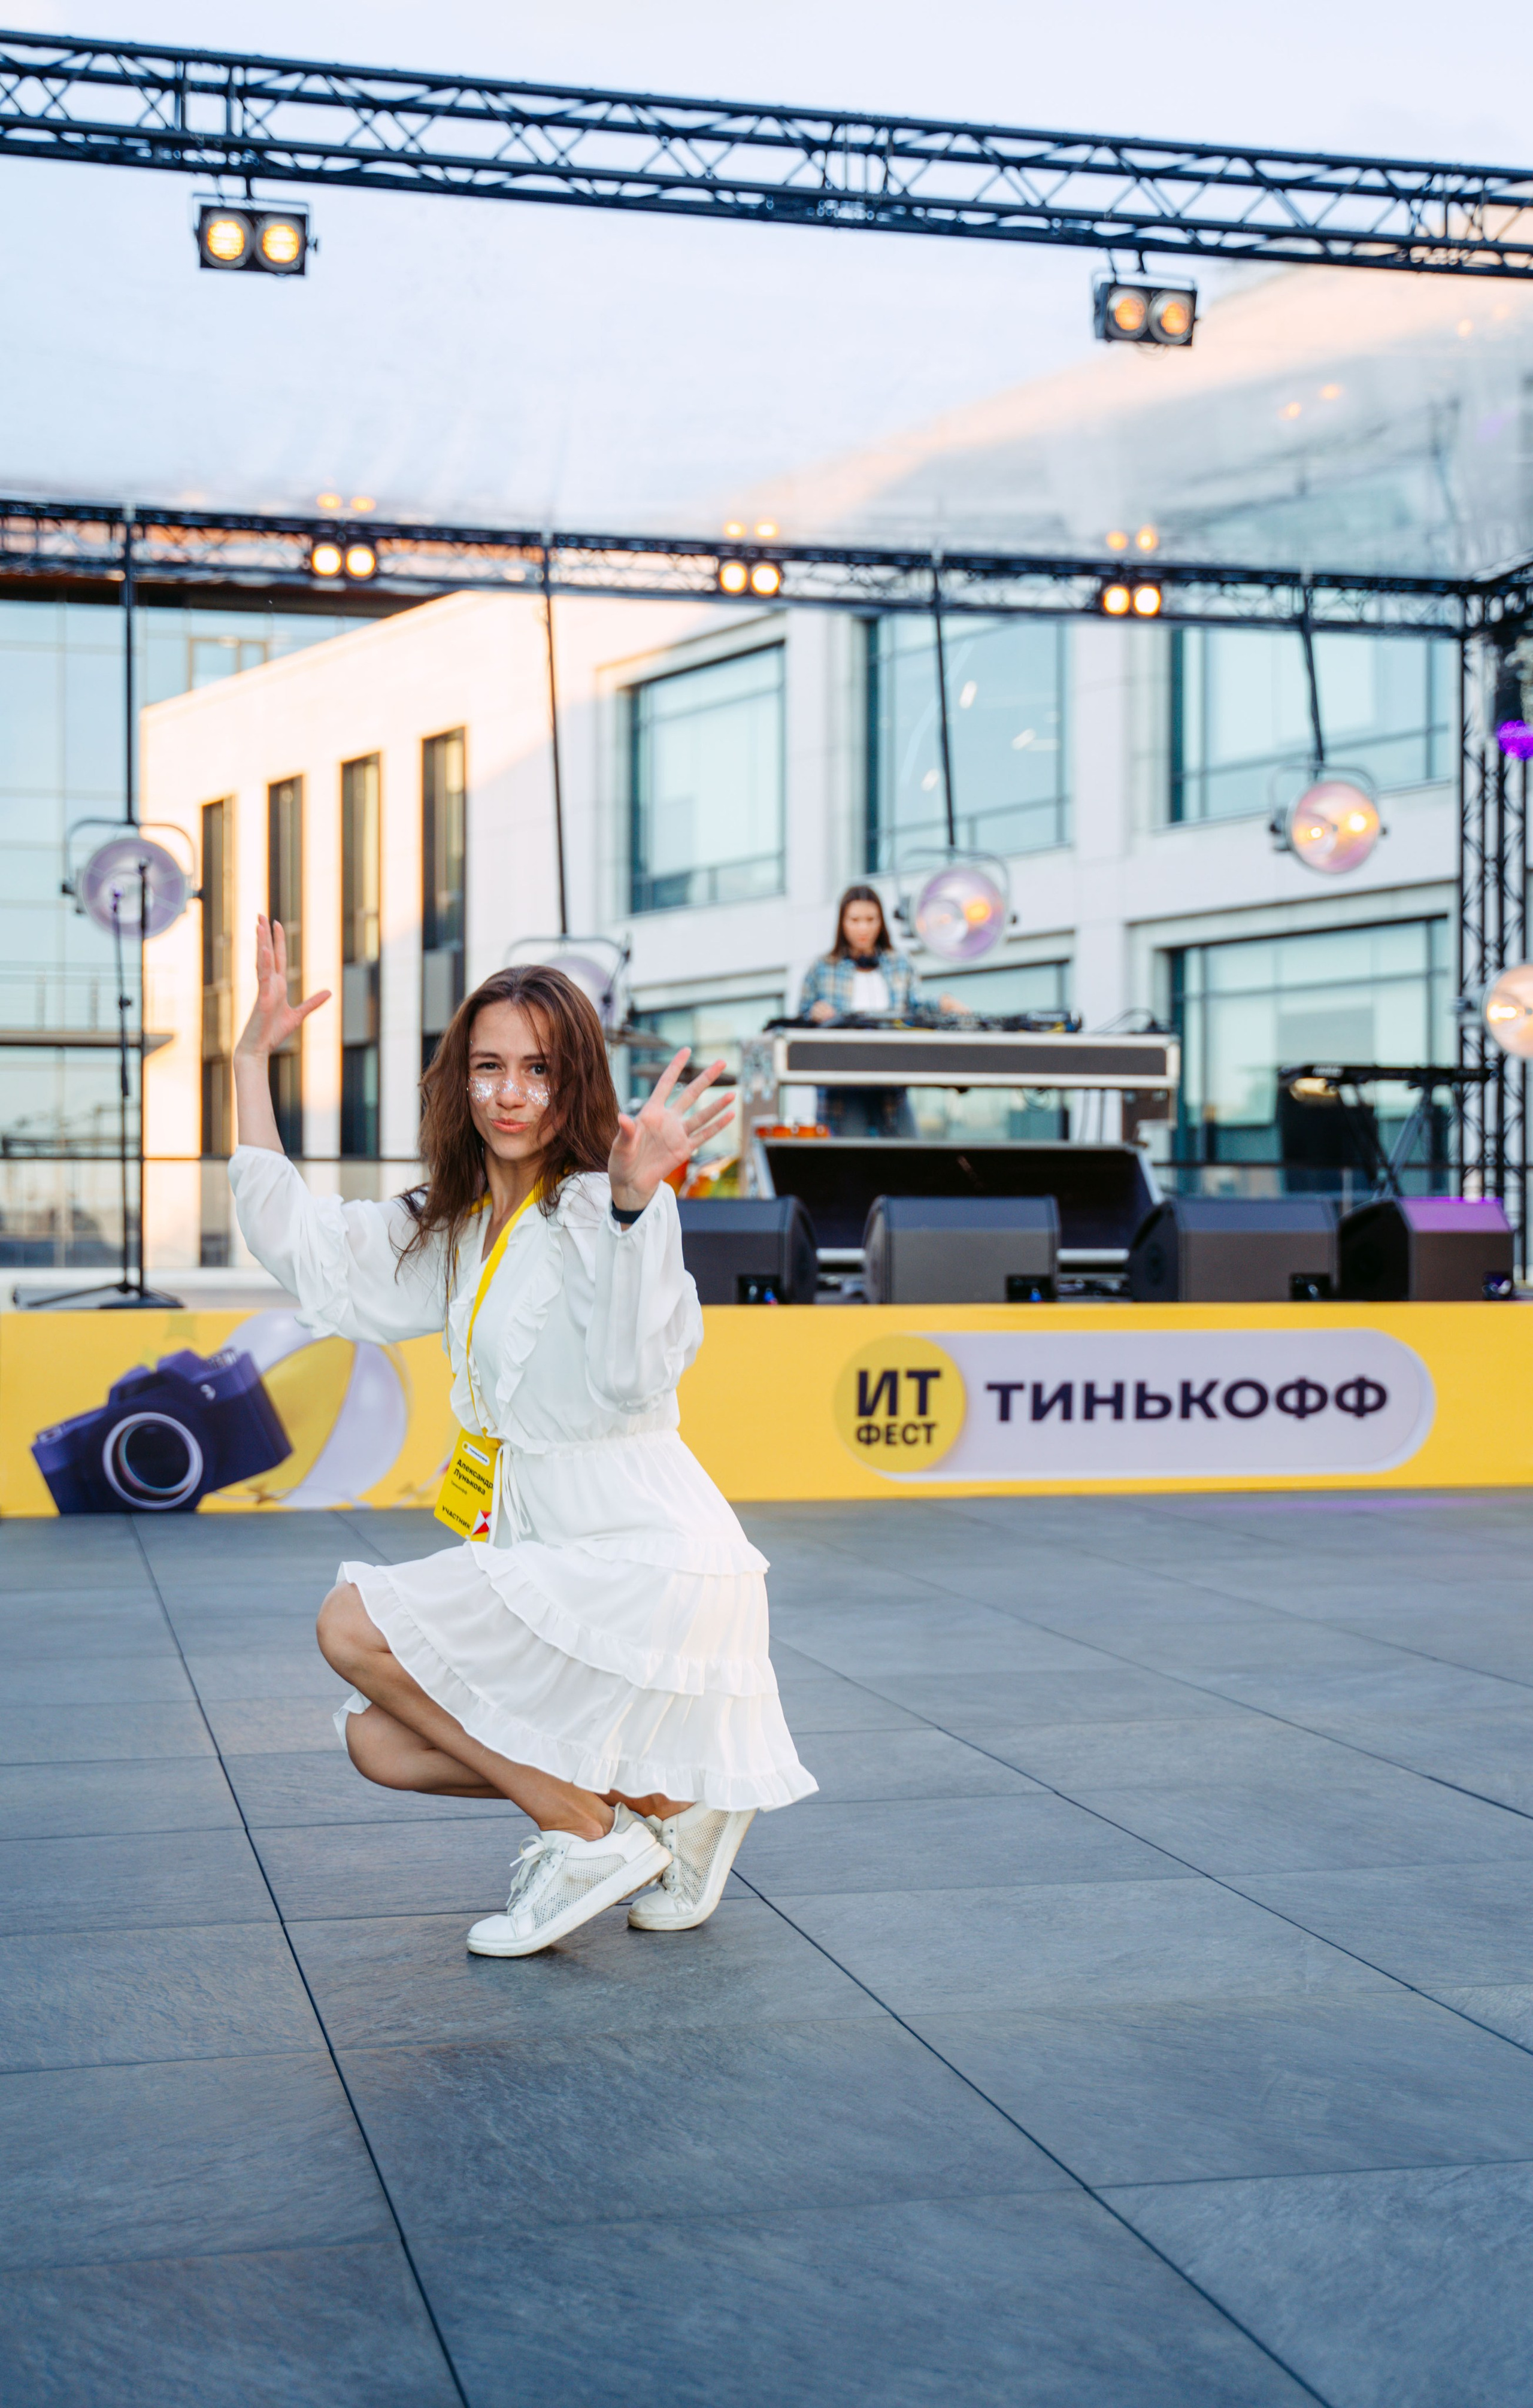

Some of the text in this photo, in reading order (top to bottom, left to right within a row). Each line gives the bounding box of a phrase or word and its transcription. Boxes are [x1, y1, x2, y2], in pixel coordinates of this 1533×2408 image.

[856, 1369, 943, 1417] ИТ
[985, 1375, 1389, 1423] ТИНЬКОФФ
[855, 1422, 937, 1447] ФЕСТ
[453, 1468, 486, 1496] Лунькова
[457, 1458, 493, 1490] Александр
[443, 1505, 471, 1530] УЧАСТНИК
